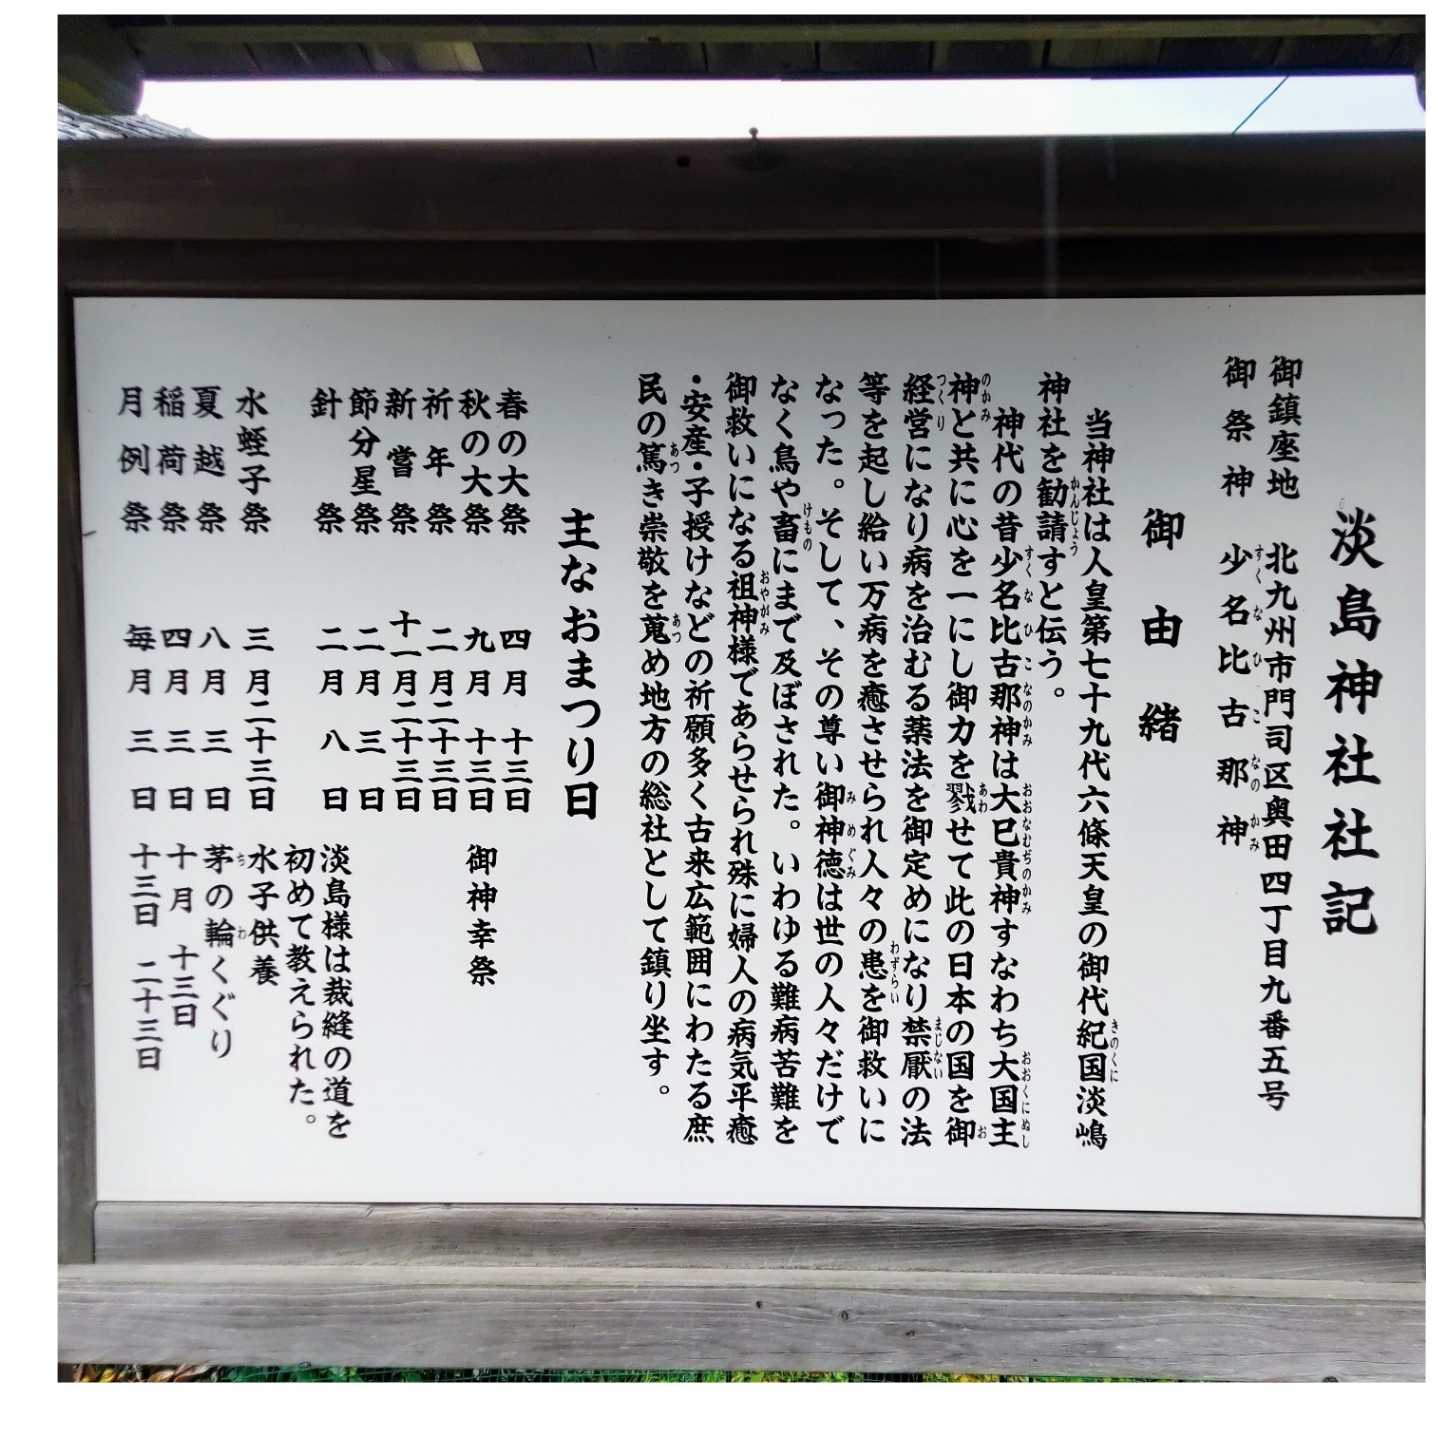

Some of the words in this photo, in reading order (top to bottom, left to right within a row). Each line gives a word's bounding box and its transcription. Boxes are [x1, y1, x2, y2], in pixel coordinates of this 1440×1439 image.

[118, 385, 152, 533] 月例祭
[153, 385, 190, 533] 稲荷祭
[191, 385, 227, 534] 夏越祭
[235, 386, 271, 534] 水蛭子祭
[347, 386, 383, 535] 節分星祭
[383, 387, 419, 535] 新嘗祭
[421, 387, 456, 535] 祈年祭
[457, 388, 494, 536] 秋の大祭
[495, 387, 530, 535] 春の大祭
[1219, 355, 1256, 497] 御祭神
[1265, 355, 1303, 499] 御鎮座地
[1033, 370, 1071, 697] 神社を勧請すと伝う。
[557, 507, 601, 820] 主なおまつり日
[1137, 507, 1185, 743] 御由緒
[1215, 542, 1253, 847] 少名比古那神
[1320, 506, 1384, 935] 淡島神社社記
[129, 842, 161, 927] 十三日
[1257, 541, 1299, 1111] 北九州市門司区奥田四丁目九番五号
[202, 843, 236, 1058] 茅の輪くぐり
[246, 843, 280, 986] 水子供養
[283, 843, 317, 1123] 初めて教えられた。
[464, 843, 498, 987] 御神幸祭
[131, 960, 163, 1070] 二十三日
[319, 842, 354, 1139] 淡島様は裁縫の道を
